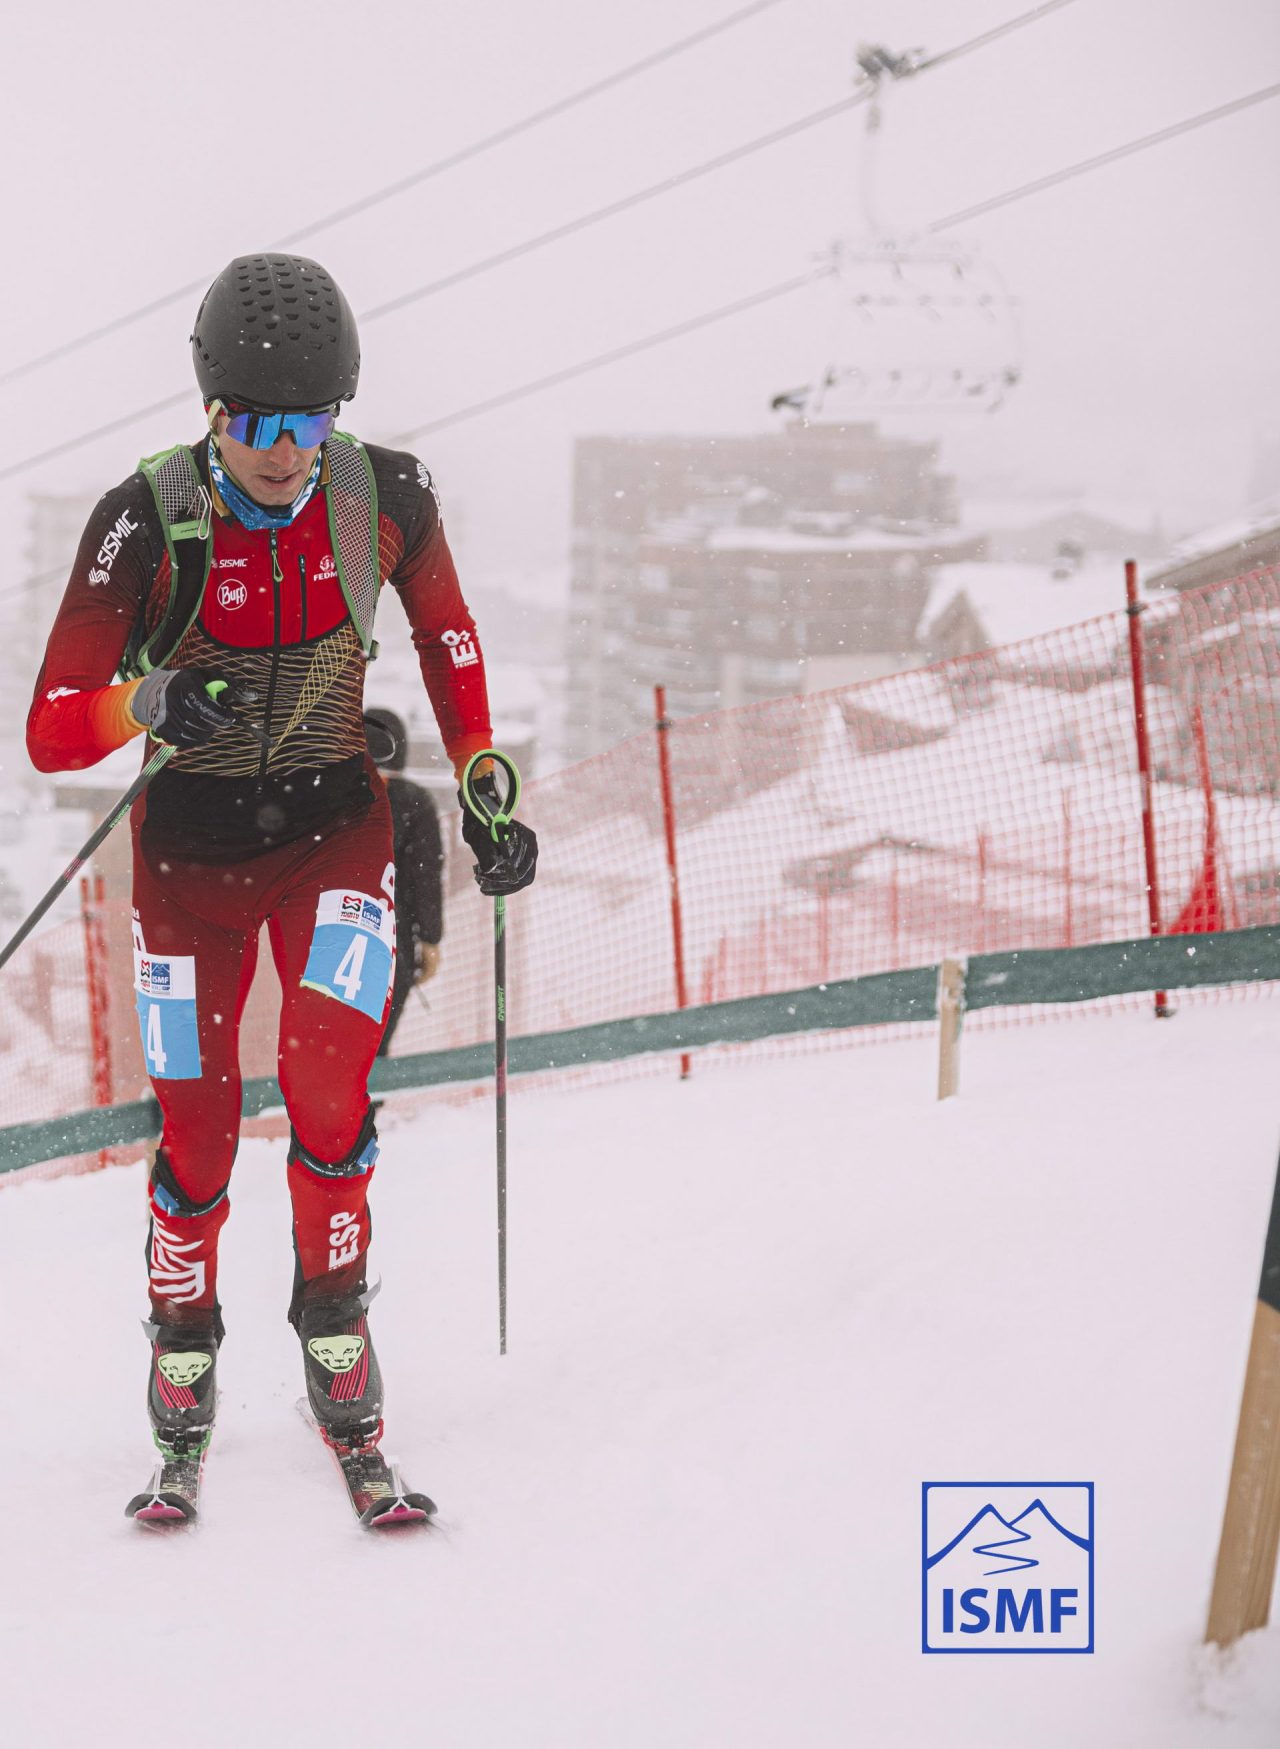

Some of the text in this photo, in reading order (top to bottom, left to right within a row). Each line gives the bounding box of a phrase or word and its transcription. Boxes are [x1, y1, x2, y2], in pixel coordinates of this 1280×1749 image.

[97, 509, 139, 571] SISMIC
[219, 558, 248, 568] SISMIC
[313, 571, 337, 581] FEDM
[333, 934, 368, 1000] 4
[147, 1004, 167, 1073] 4
[329, 1211, 361, 1268] ESP
